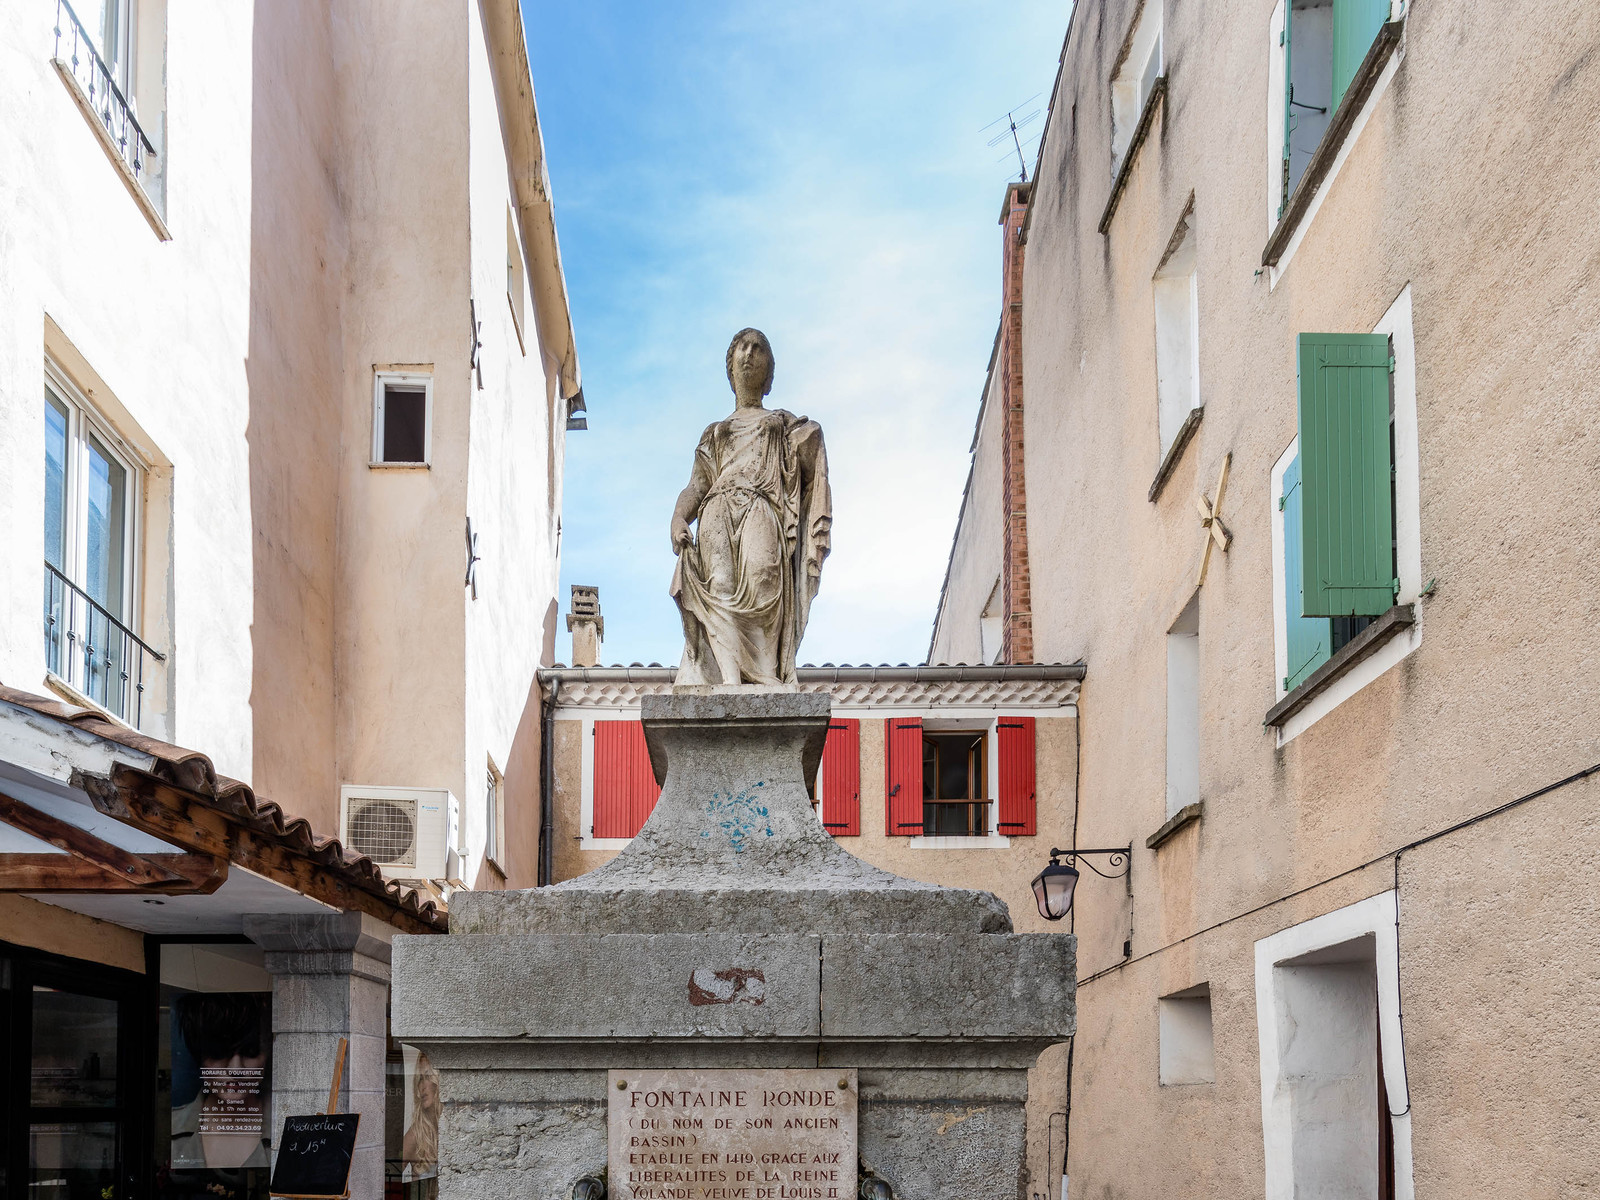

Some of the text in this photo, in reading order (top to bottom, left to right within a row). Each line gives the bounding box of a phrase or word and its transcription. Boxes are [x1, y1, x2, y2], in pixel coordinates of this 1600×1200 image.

[630, 1090, 837, 1108] FONTAINE RONDE
[672, 1118, 703, 1130] NOM
[714, 1118, 733, 1130] DE
[745, 1118, 773, 1130] SON
[783, 1118, 838, 1129] ANCIEN
[629, 1153, 694, 1165] ETABLIE
[701, 1153, 719, 1165] EN
[761, 1152, 807, 1165] GRACE
[812, 1152, 840, 1164] AUX
[629, 1170, 838, 1182] LIBERALITES DE LA REINE
[702, 1188, 750, 1199] VEUVE
[756, 1188, 775, 1199] DE
[781, 1185, 822, 1199] LOUIS
[827, 1187, 839, 1199] II
